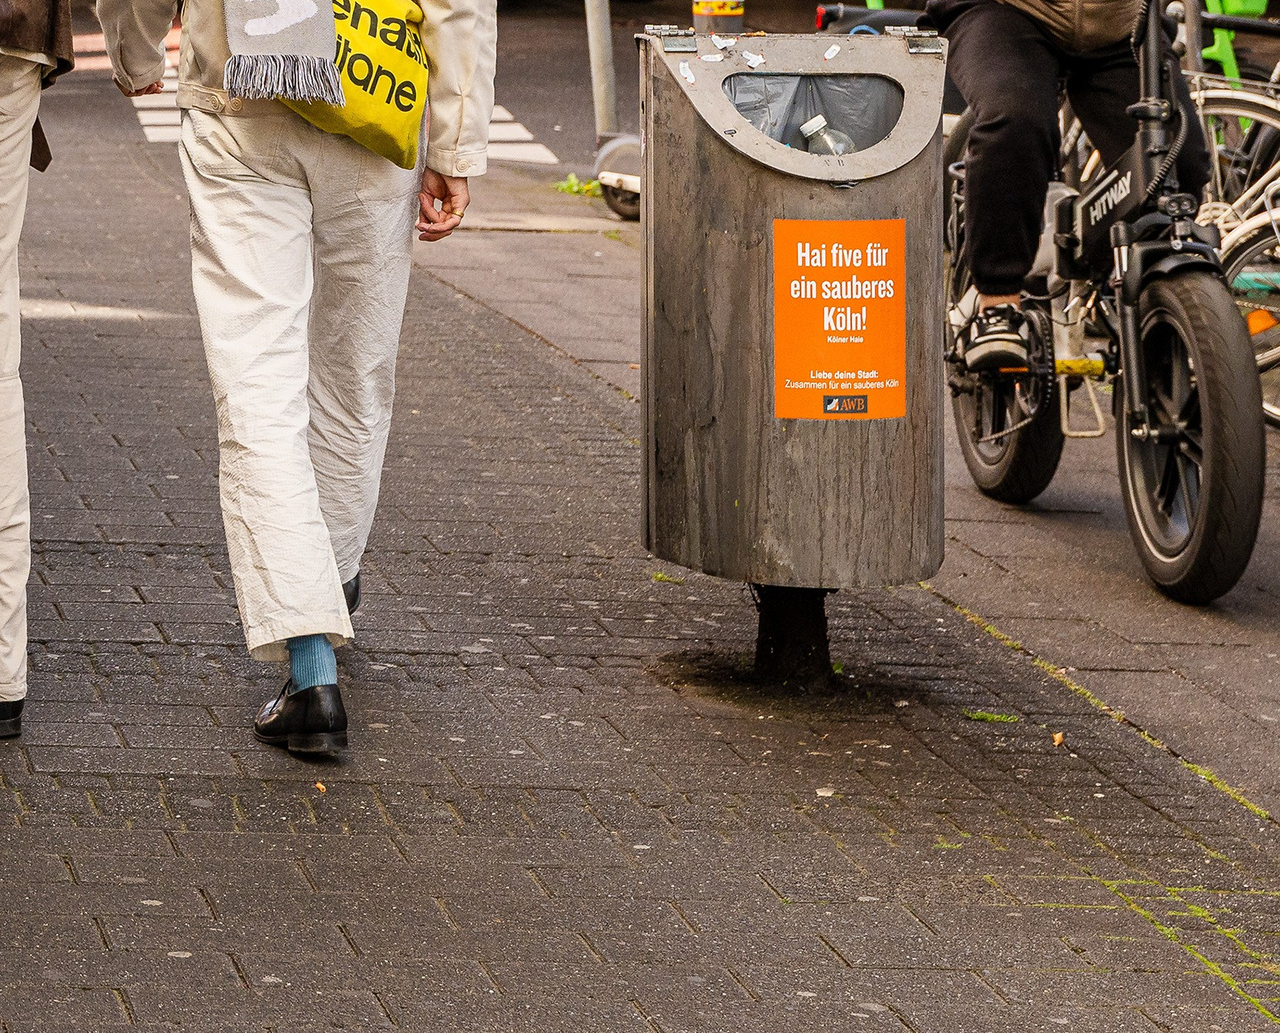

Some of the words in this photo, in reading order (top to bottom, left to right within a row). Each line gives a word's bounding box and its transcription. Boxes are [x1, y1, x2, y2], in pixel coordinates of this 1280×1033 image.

[333, 33, 417, 112] itane
[1089, 170, 1132, 226] HITWAY
[797, 242, 826, 267] Hai
[830, 242, 862, 267] five
[865, 242, 889, 267] für
[790, 275, 817, 299] ein
[821, 274, 894, 299] sauberes
[823, 306, 867, 331] Köln!
[827, 335, 849, 343] Kölner
[784, 379, 827, 389] Zusammen
[828, 380, 839, 390] für
[840, 381, 852, 389] ein
[853, 380, 885, 389] sauberes
[885, 379, 899, 388] Köln
[810, 370, 833, 379] Liebe
[834, 370, 856, 379] deine
[857, 370, 879, 379] Stadt:
[839, 397, 865, 411] AWB
